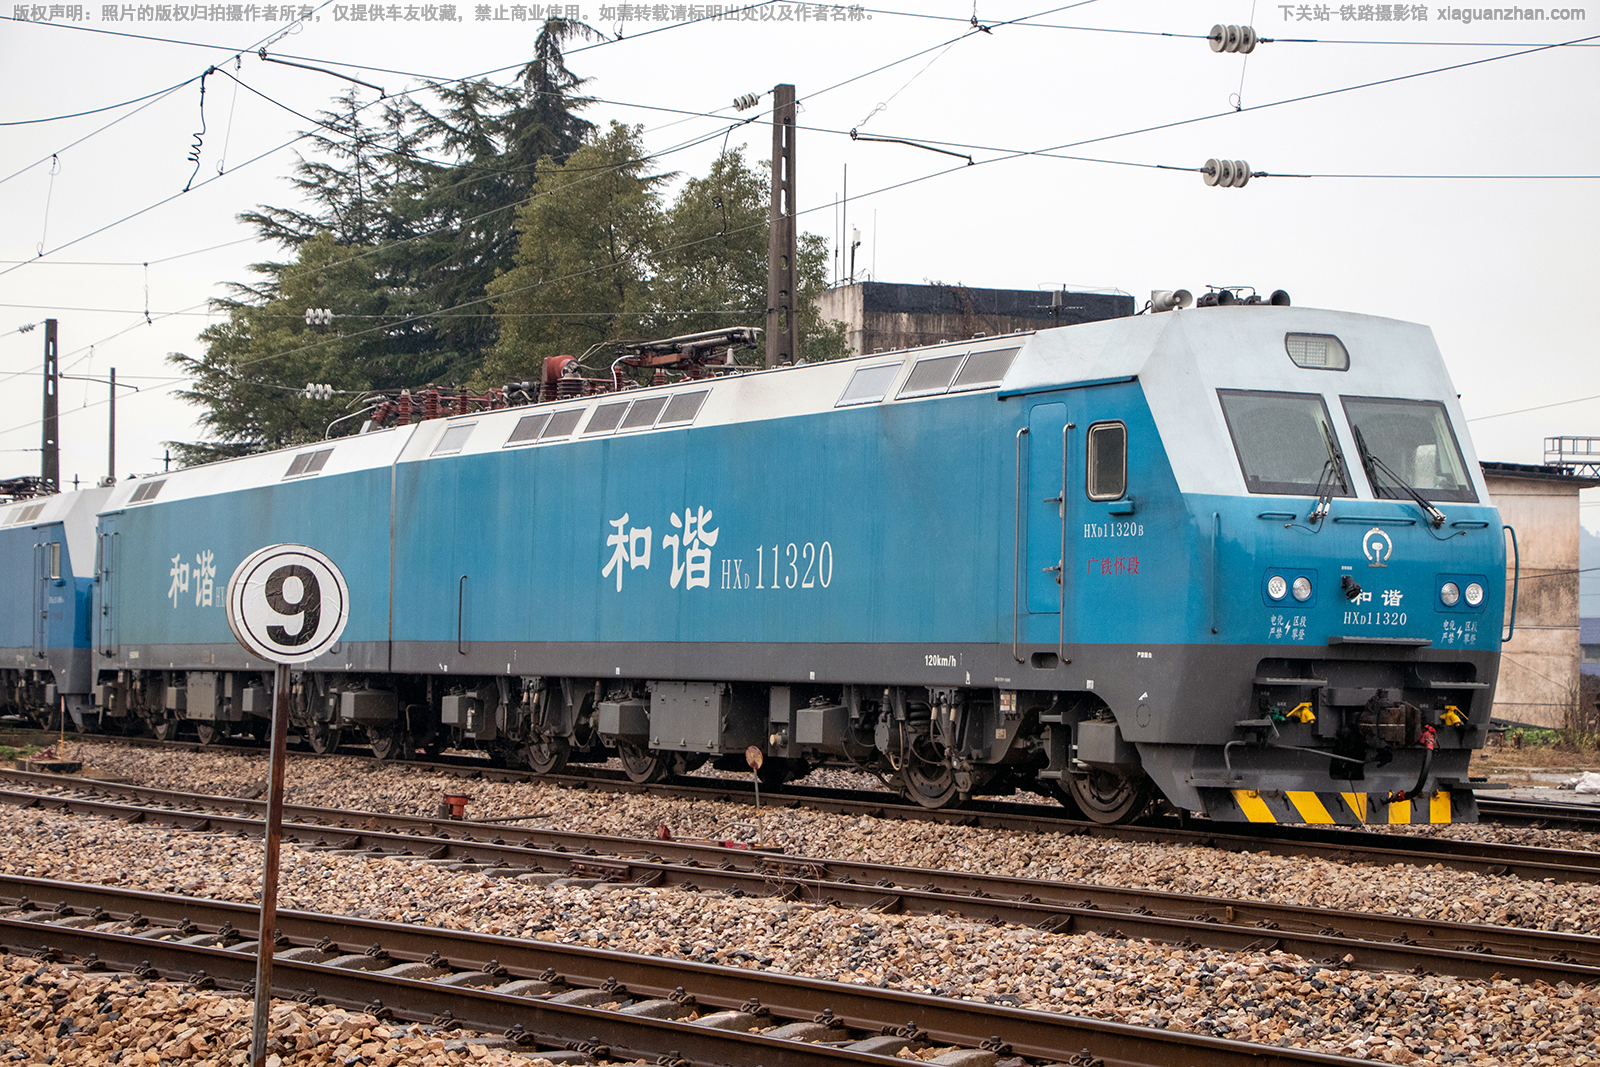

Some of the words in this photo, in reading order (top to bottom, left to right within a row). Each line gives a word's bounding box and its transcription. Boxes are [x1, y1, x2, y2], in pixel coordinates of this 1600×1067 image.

[601, 505, 719, 592] 和谐
[1087, 556, 1140, 575] 广铁怀段
[168, 549, 216, 608] 和谐
[265, 564, 321, 646] 9
[925, 654, 957, 667] 120km/h
